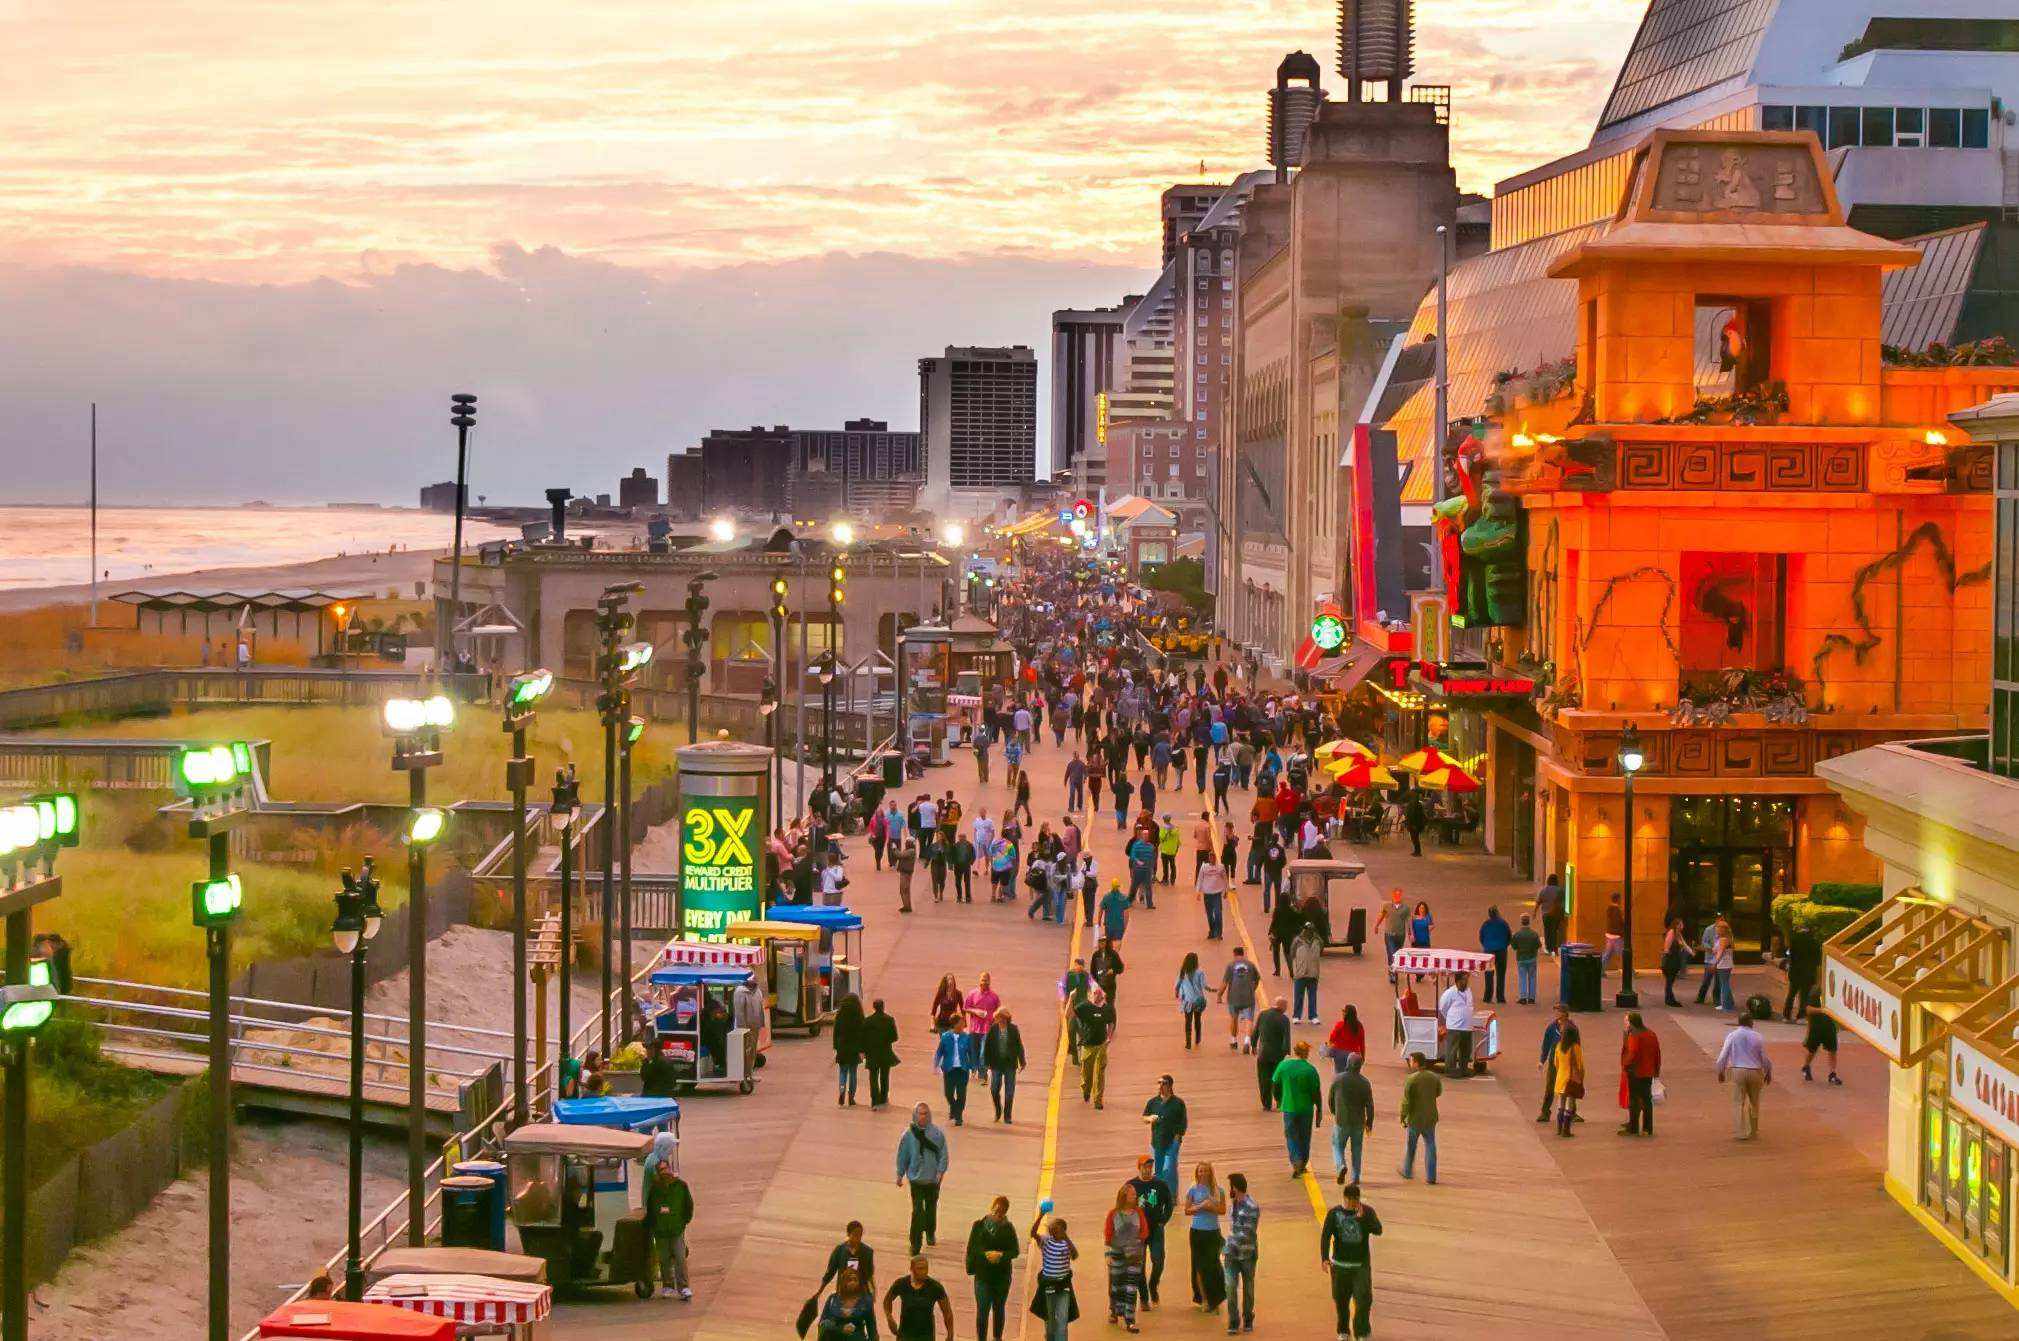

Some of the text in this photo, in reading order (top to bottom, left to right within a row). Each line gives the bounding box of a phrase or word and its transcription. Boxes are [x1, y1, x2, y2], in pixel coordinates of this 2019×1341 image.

[684, 808, 754, 865] 3X
[722, 866, 753, 877] CREDIT
[684, 876, 753, 891] MULTIPLIER
[685, 909, 752, 928] EVERY DAY
[1842, 977, 1882, 1030] CAESARS
